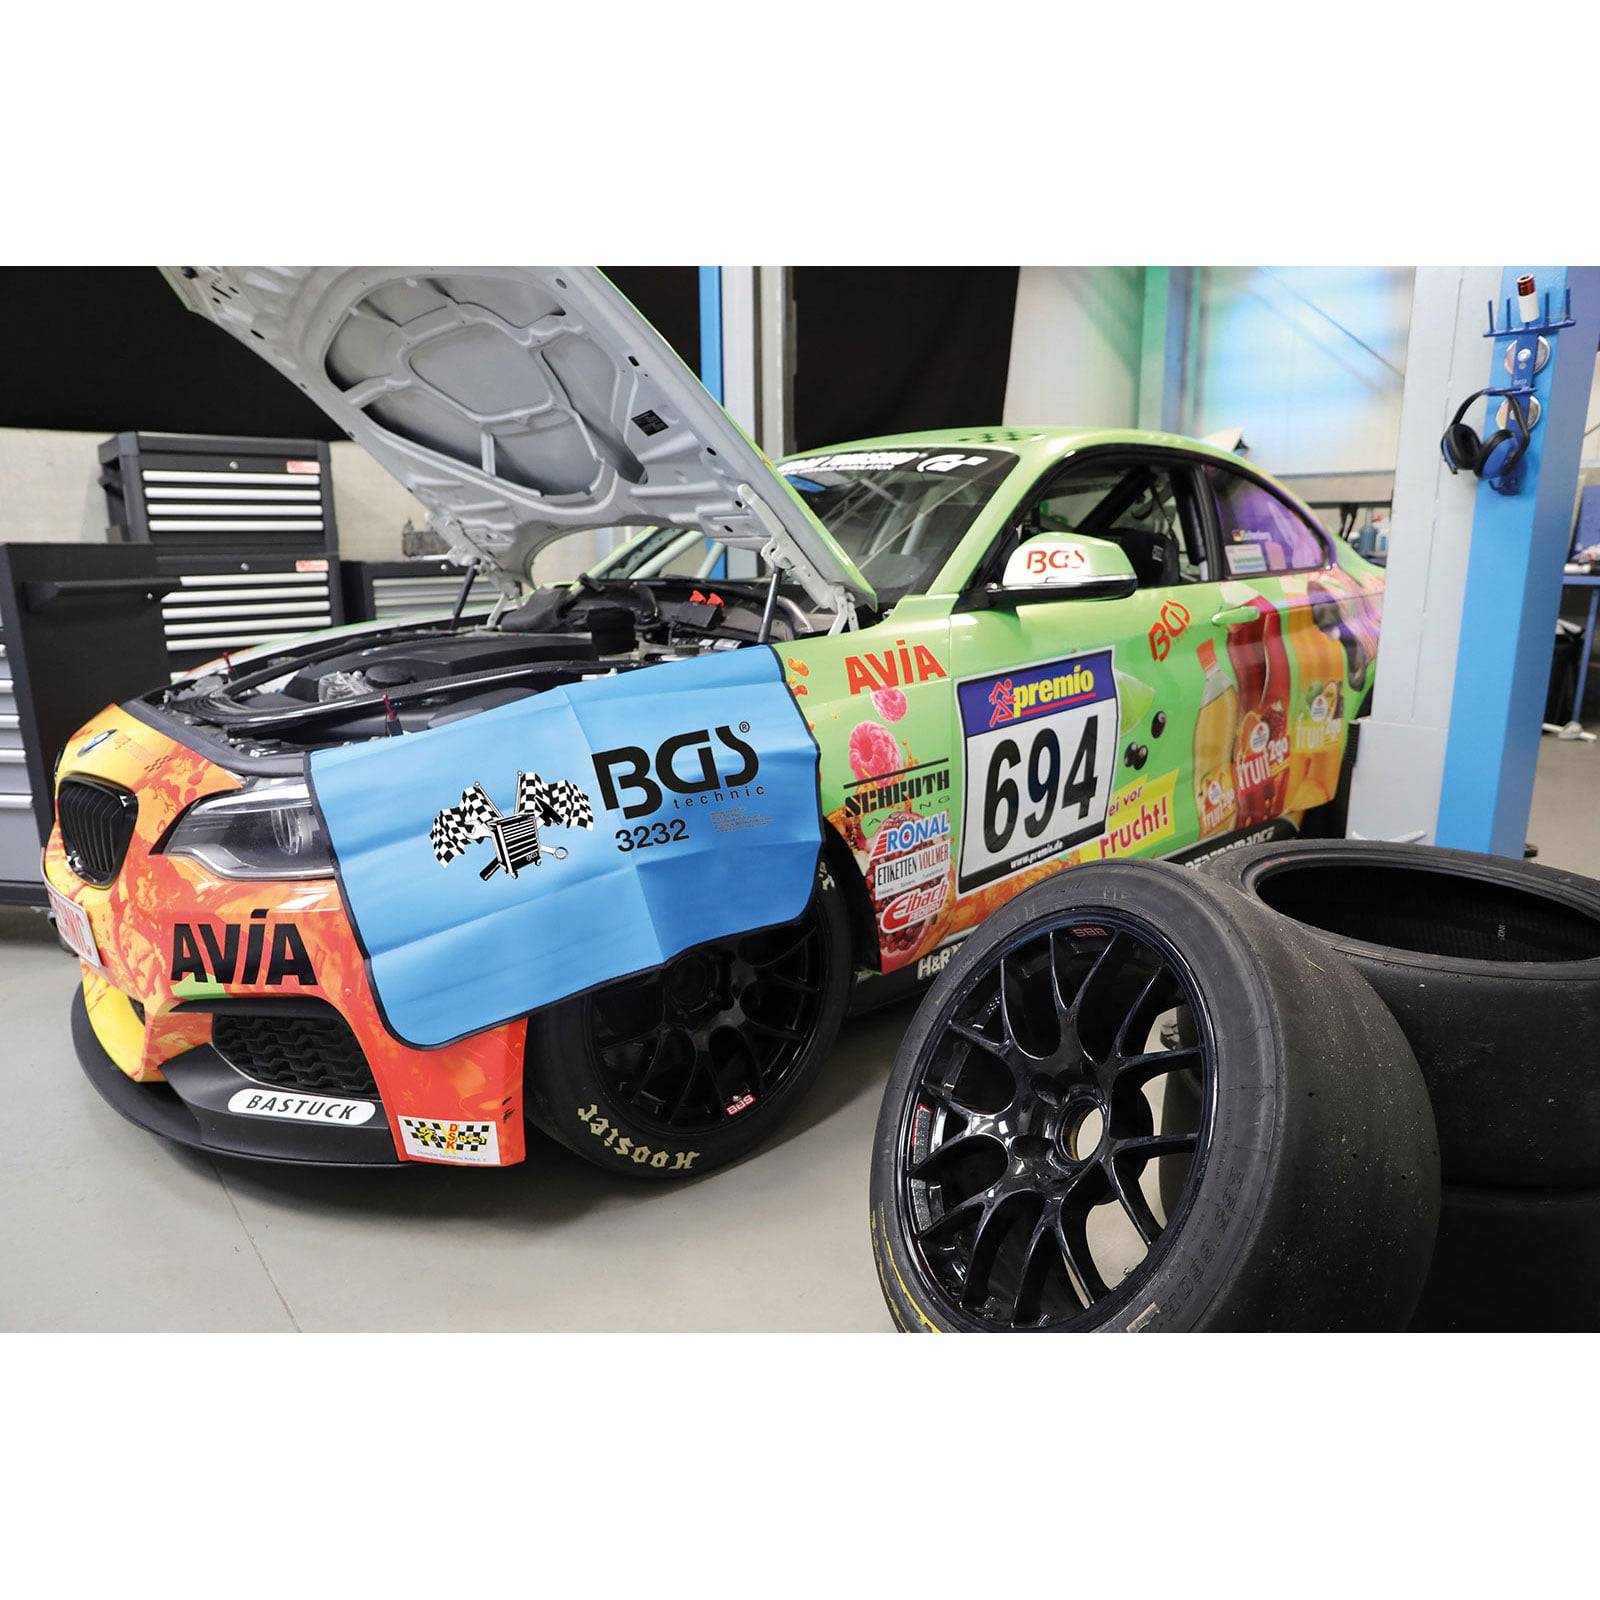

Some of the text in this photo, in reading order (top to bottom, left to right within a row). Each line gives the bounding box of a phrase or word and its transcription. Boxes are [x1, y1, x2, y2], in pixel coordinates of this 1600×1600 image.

[1013, 664, 1095, 718] premio
[673, 785, 766, 809] technic
[845, 769, 950, 818] SCHROTH
[981, 714, 1099, 854] 694
[615, 818, 690, 852] 3232
[887, 813, 949, 851] RONAL
[877, 856, 917, 886] ETIKETTEN
[246, 1095, 357, 1120] BASTUCK
[577, 1103, 700, 1170] Hoosier
